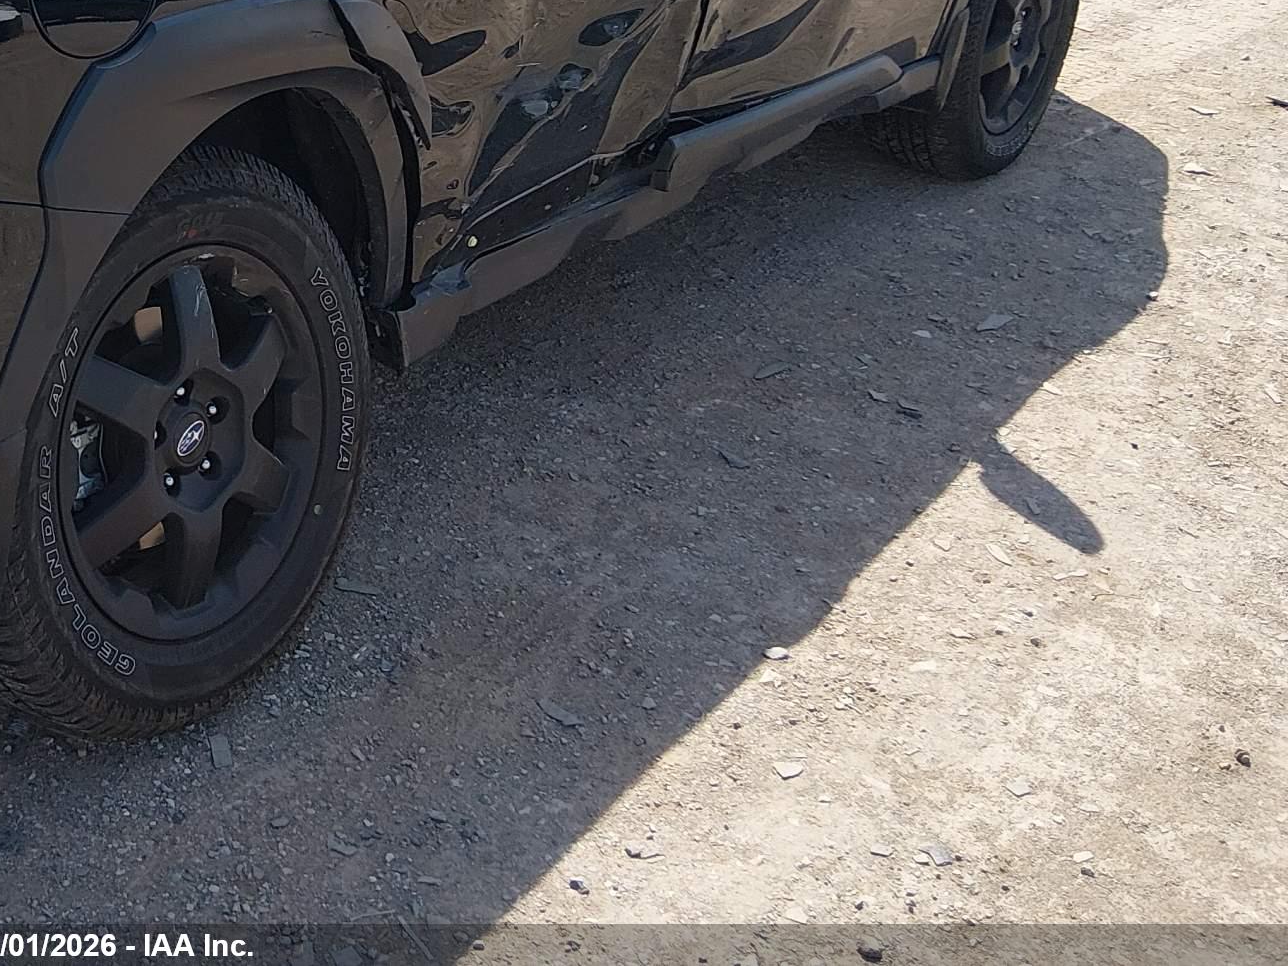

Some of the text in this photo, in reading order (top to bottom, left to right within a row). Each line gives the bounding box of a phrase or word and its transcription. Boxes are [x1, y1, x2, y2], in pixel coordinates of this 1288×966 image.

[39, 327, 137, 676] GEOLANDAR A/T
[311, 266, 356, 471] YOKOHAMA
